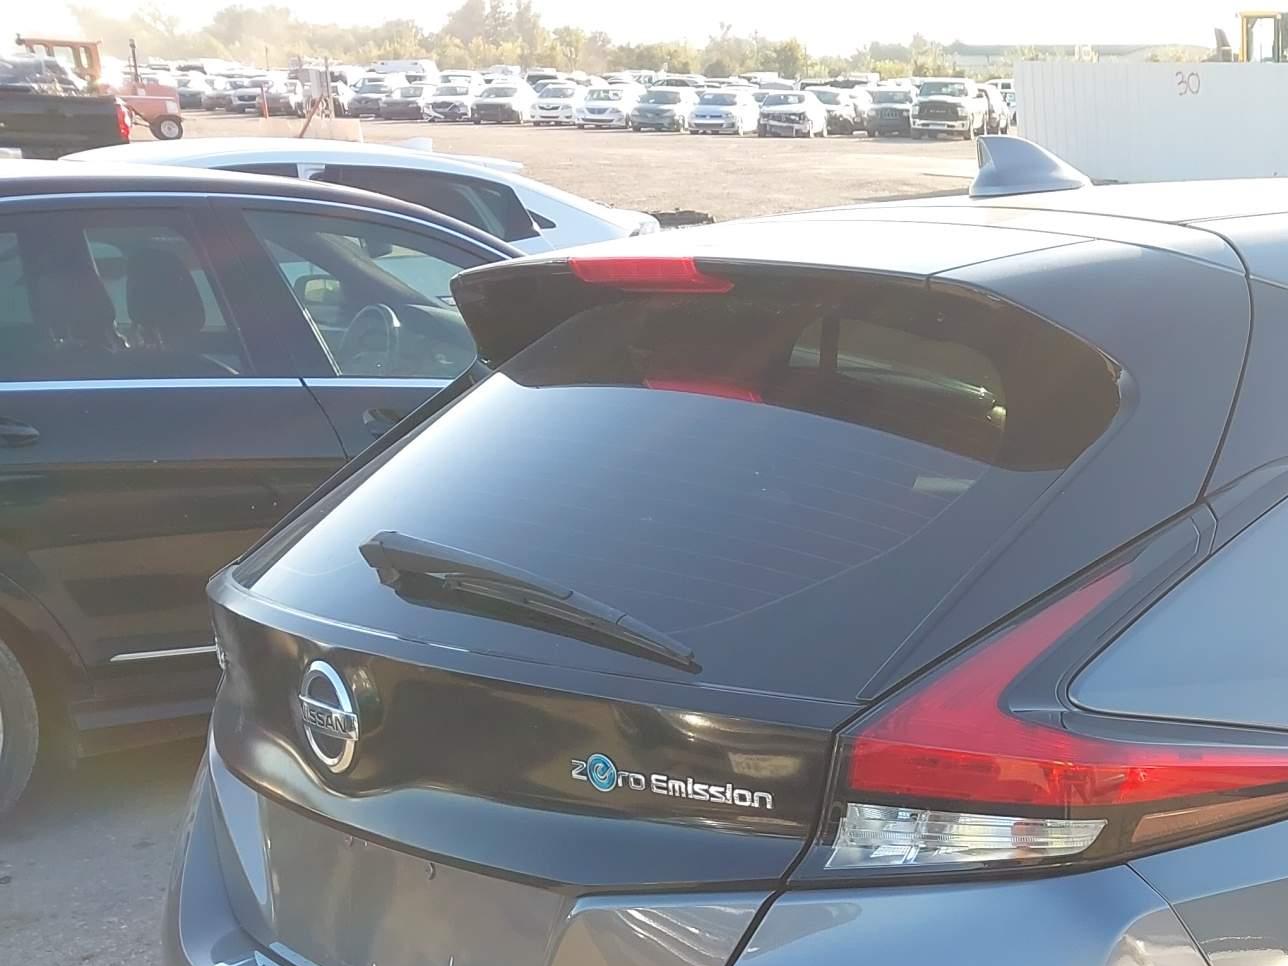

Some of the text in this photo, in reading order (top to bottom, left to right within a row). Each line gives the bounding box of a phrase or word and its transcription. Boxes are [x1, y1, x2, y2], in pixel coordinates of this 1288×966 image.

[1176, 71, 1201, 96] 30
[302, 702, 347, 733] NISSAN
[651, 774, 773, 809] Emission
